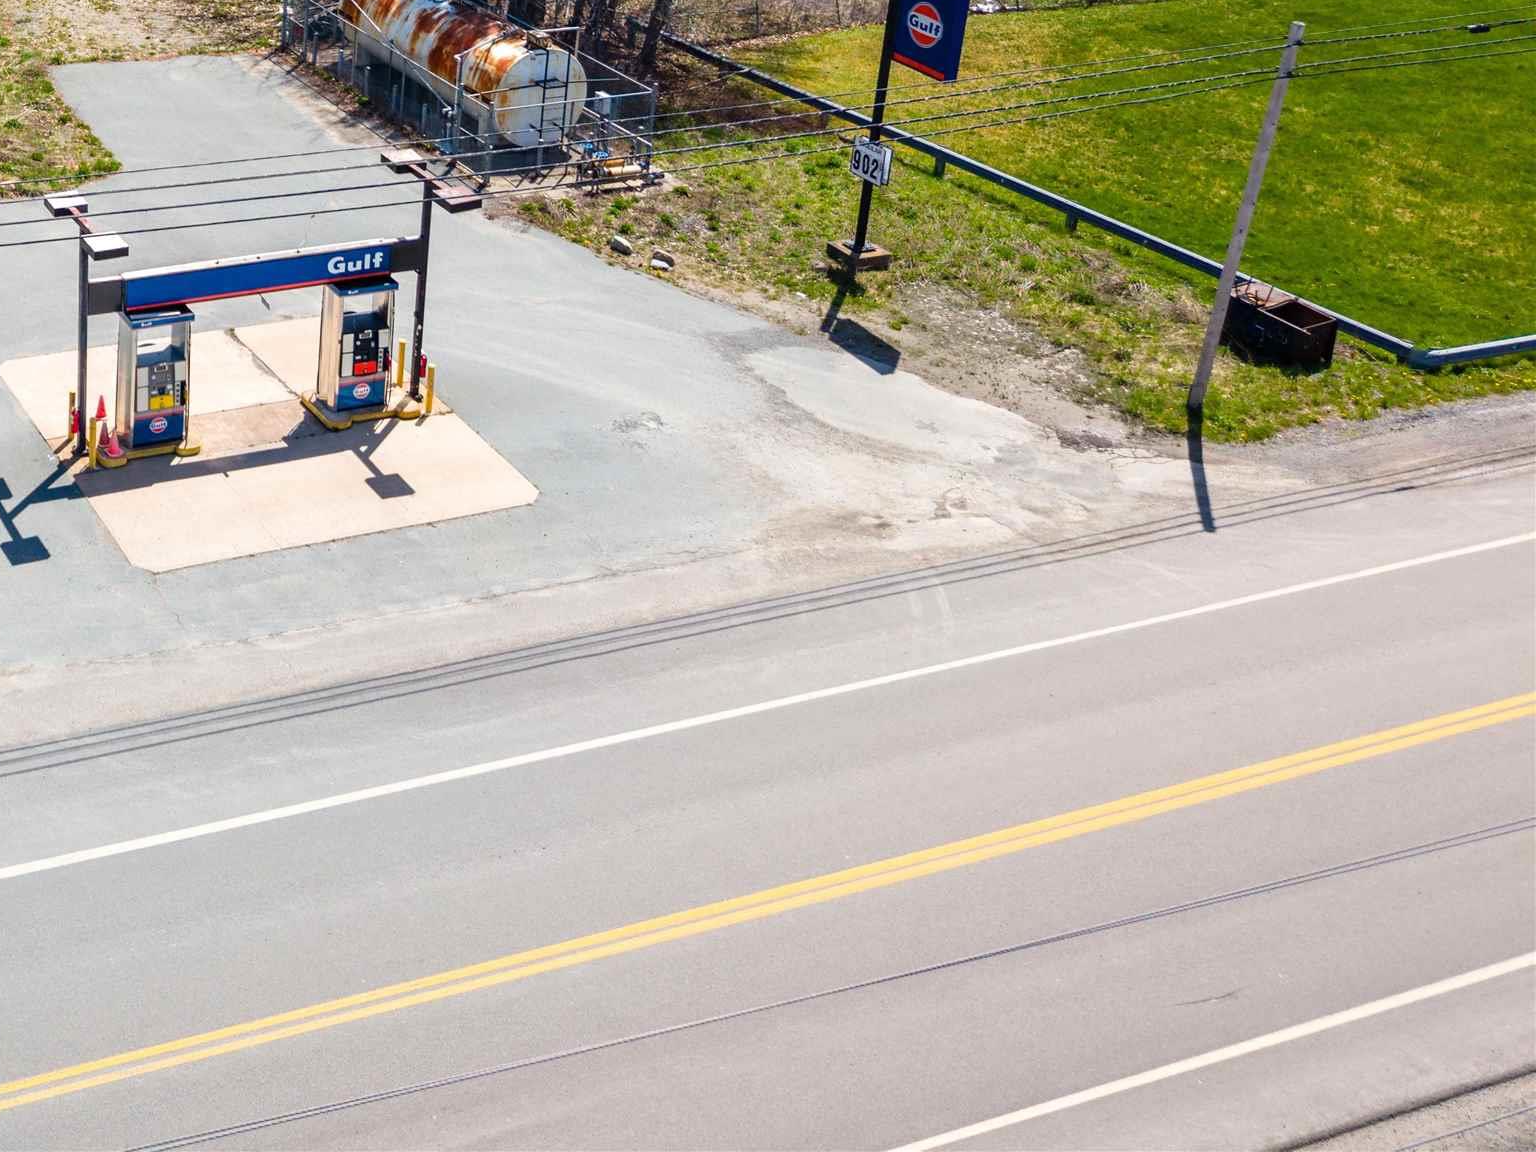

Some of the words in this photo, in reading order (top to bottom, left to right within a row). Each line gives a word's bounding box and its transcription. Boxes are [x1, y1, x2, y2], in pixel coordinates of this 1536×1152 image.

[909, 14, 941, 37] Gulf
[853, 149, 879, 180] 902
[327, 251, 384, 275] Gulf
